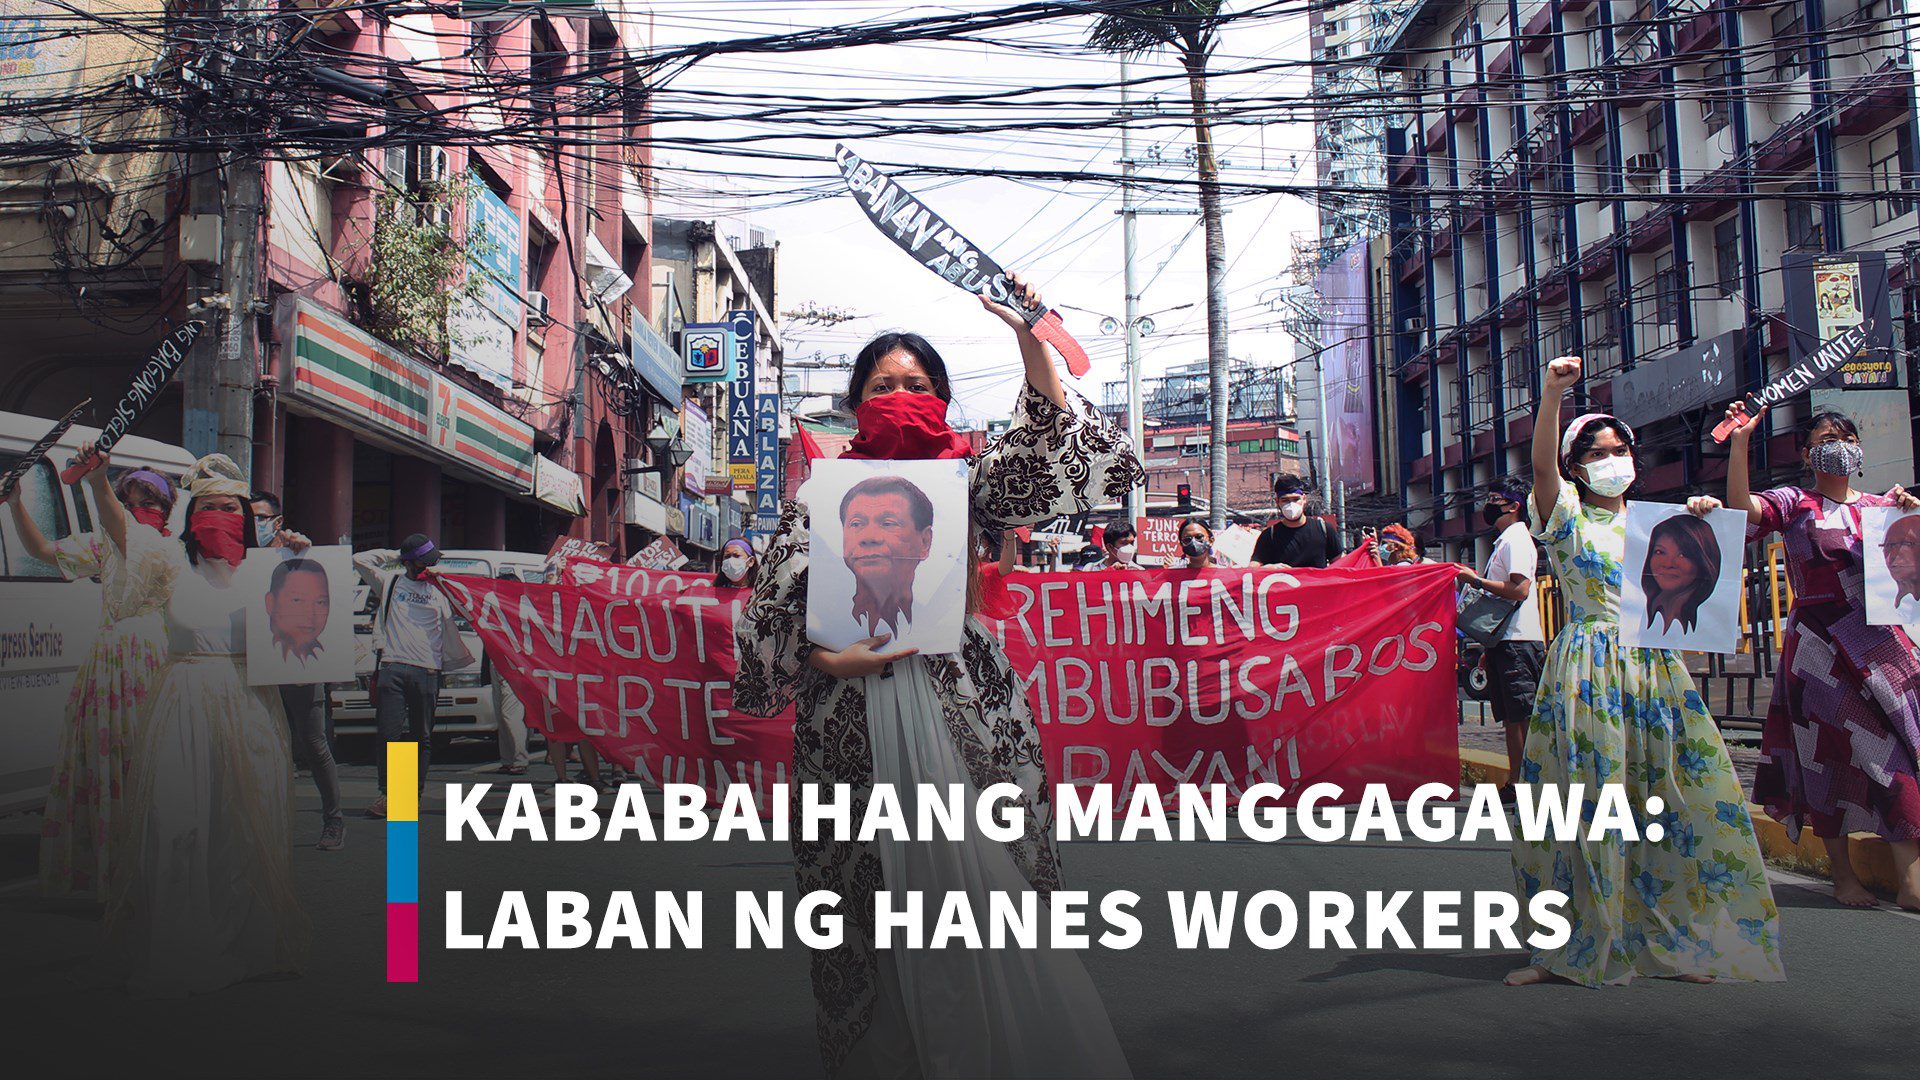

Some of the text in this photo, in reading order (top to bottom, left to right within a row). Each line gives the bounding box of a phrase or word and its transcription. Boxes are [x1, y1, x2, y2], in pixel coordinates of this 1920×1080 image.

[834, 147, 980, 271] LABANAN ANG
[127, 338, 182, 411] BAGONG
[732, 312, 753, 458] CEBUANA
[1753, 363, 1817, 407] WOMEN
[1812, 323, 1867, 373] UNITE!
[100, 398, 136, 450] SIGLO
[759, 398, 776, 509] ABLAZA
[1142, 530, 1181, 544] TERRO
[1146, 518, 1180, 532] JUNK
[1152, 542, 1178, 554] LAW
[0, 621, 64, 668] press Service
[997, 572, 1301, 648] REHIMENG
